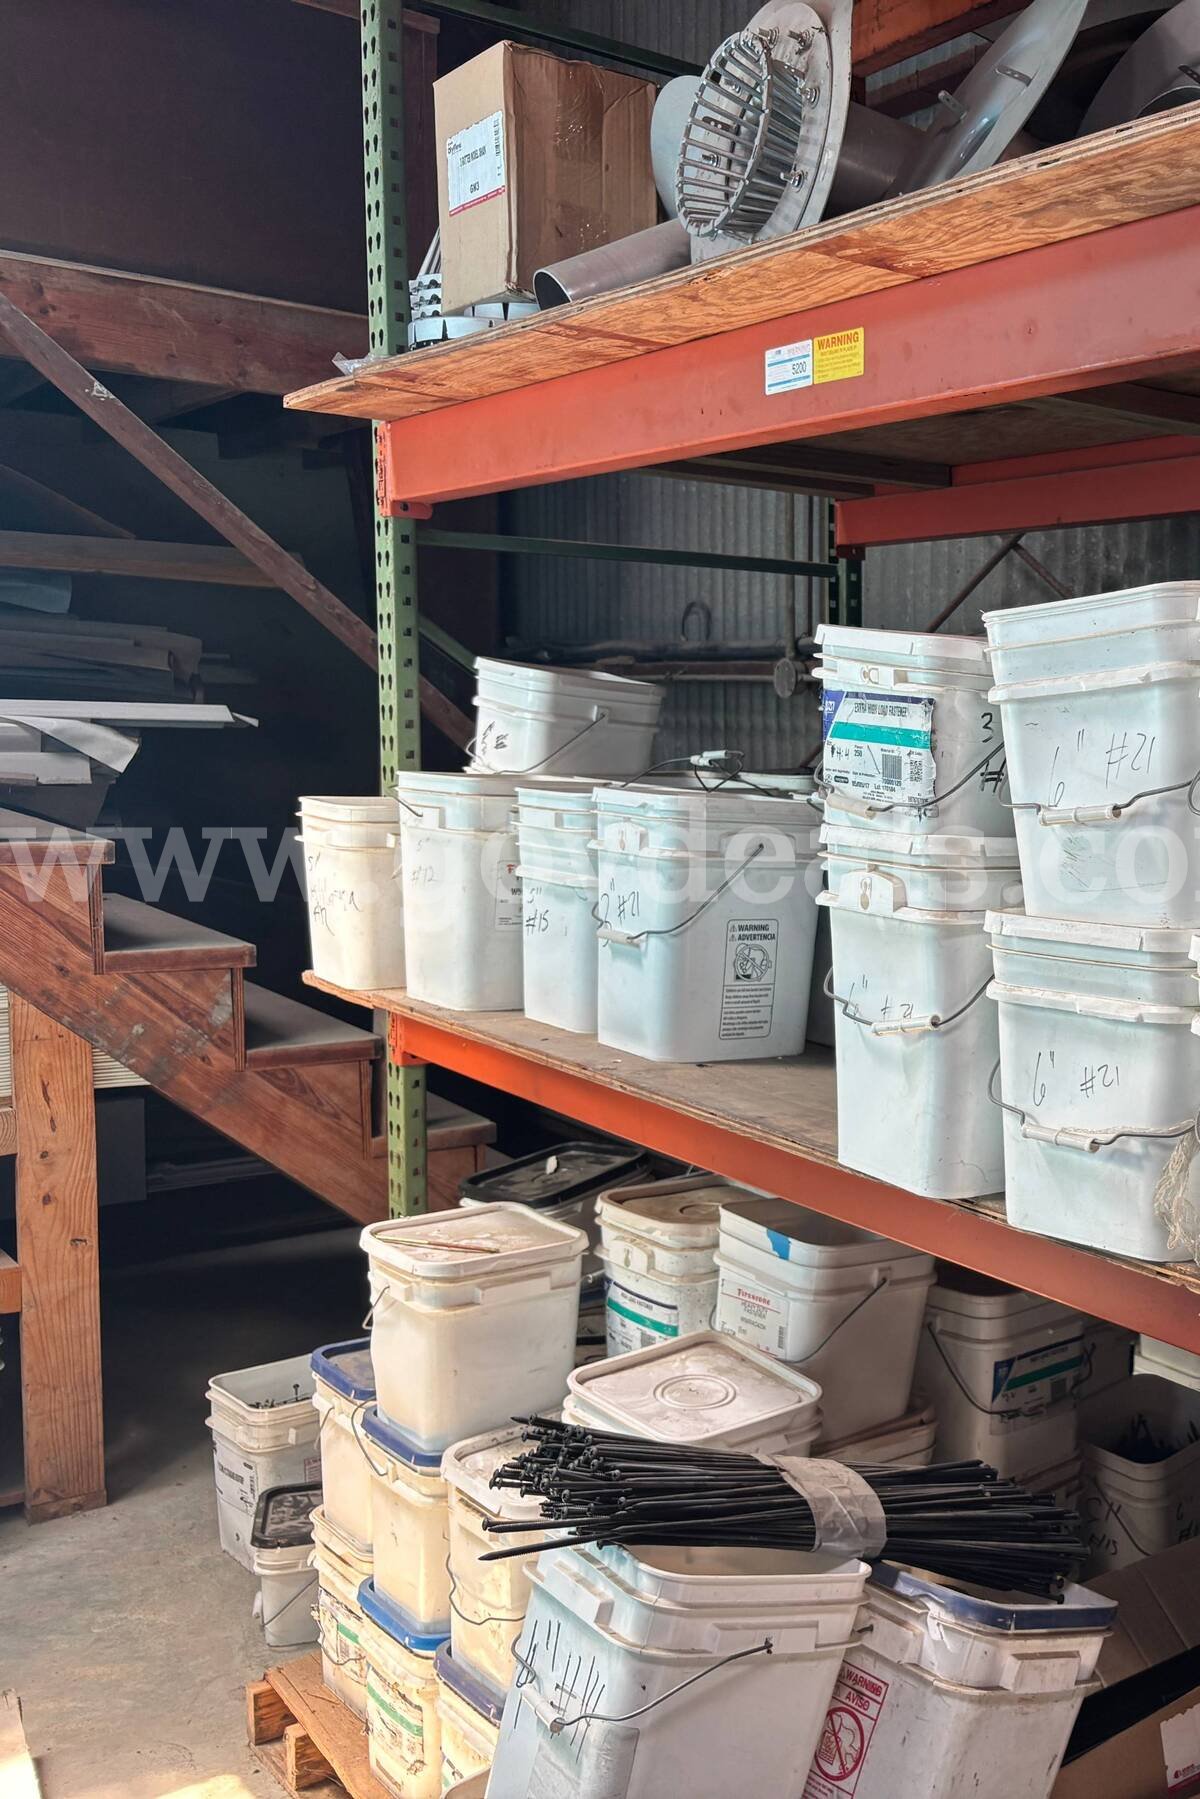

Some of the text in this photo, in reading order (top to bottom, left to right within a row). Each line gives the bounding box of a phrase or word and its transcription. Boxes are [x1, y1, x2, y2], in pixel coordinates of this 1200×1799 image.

[817, 331, 859, 350] WARNING
[1105, 731, 1156, 790] #21
[525, 909, 549, 936] #15
[738, 924, 770, 932] WARNING
[738, 933, 776, 941] ADVERTENCIA
[1080, 1064, 1120, 1099] #21
[846, 1668, 884, 1698] WARNING
[845, 1690, 871, 1712] AVISO
